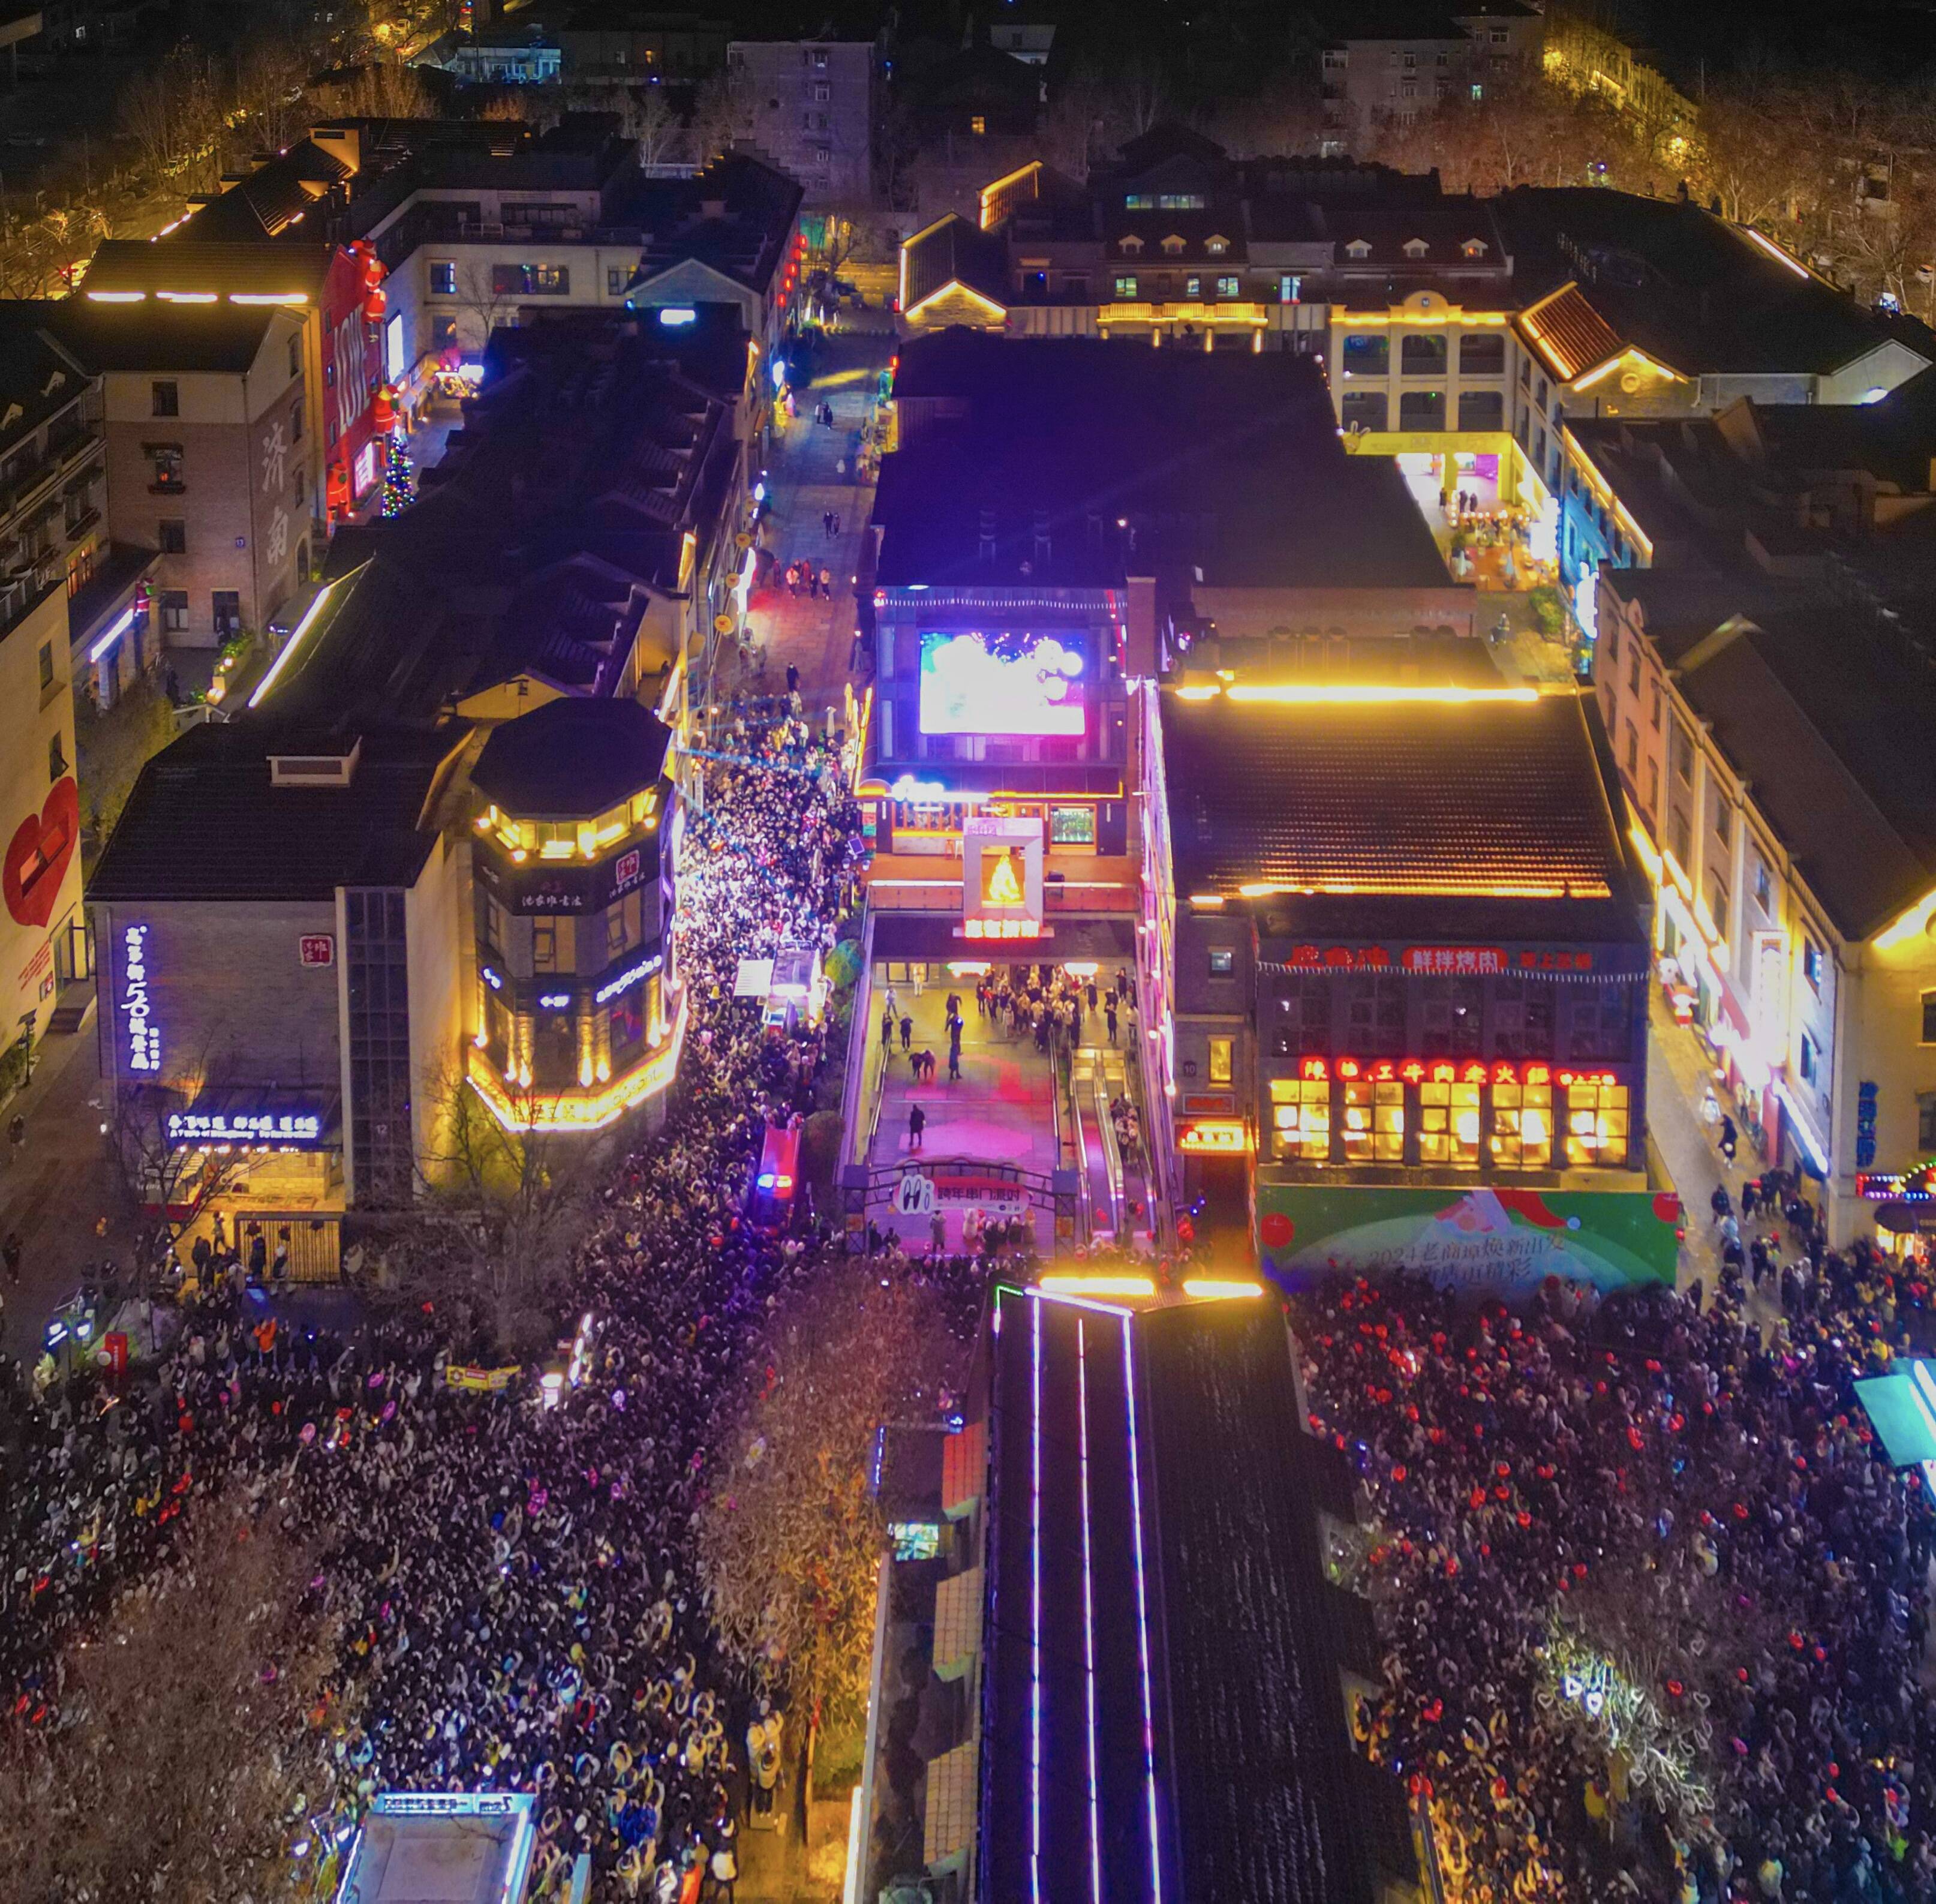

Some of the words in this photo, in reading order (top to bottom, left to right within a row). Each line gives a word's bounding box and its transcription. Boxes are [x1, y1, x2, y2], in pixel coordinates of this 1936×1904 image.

[334, 302, 371, 437] LOVE
[261, 422, 288, 565] 济南
[1185, 1065, 1195, 1074] 10
[376, 1124, 387, 1135] 12
[903, 1179, 930, 1211] Hi
